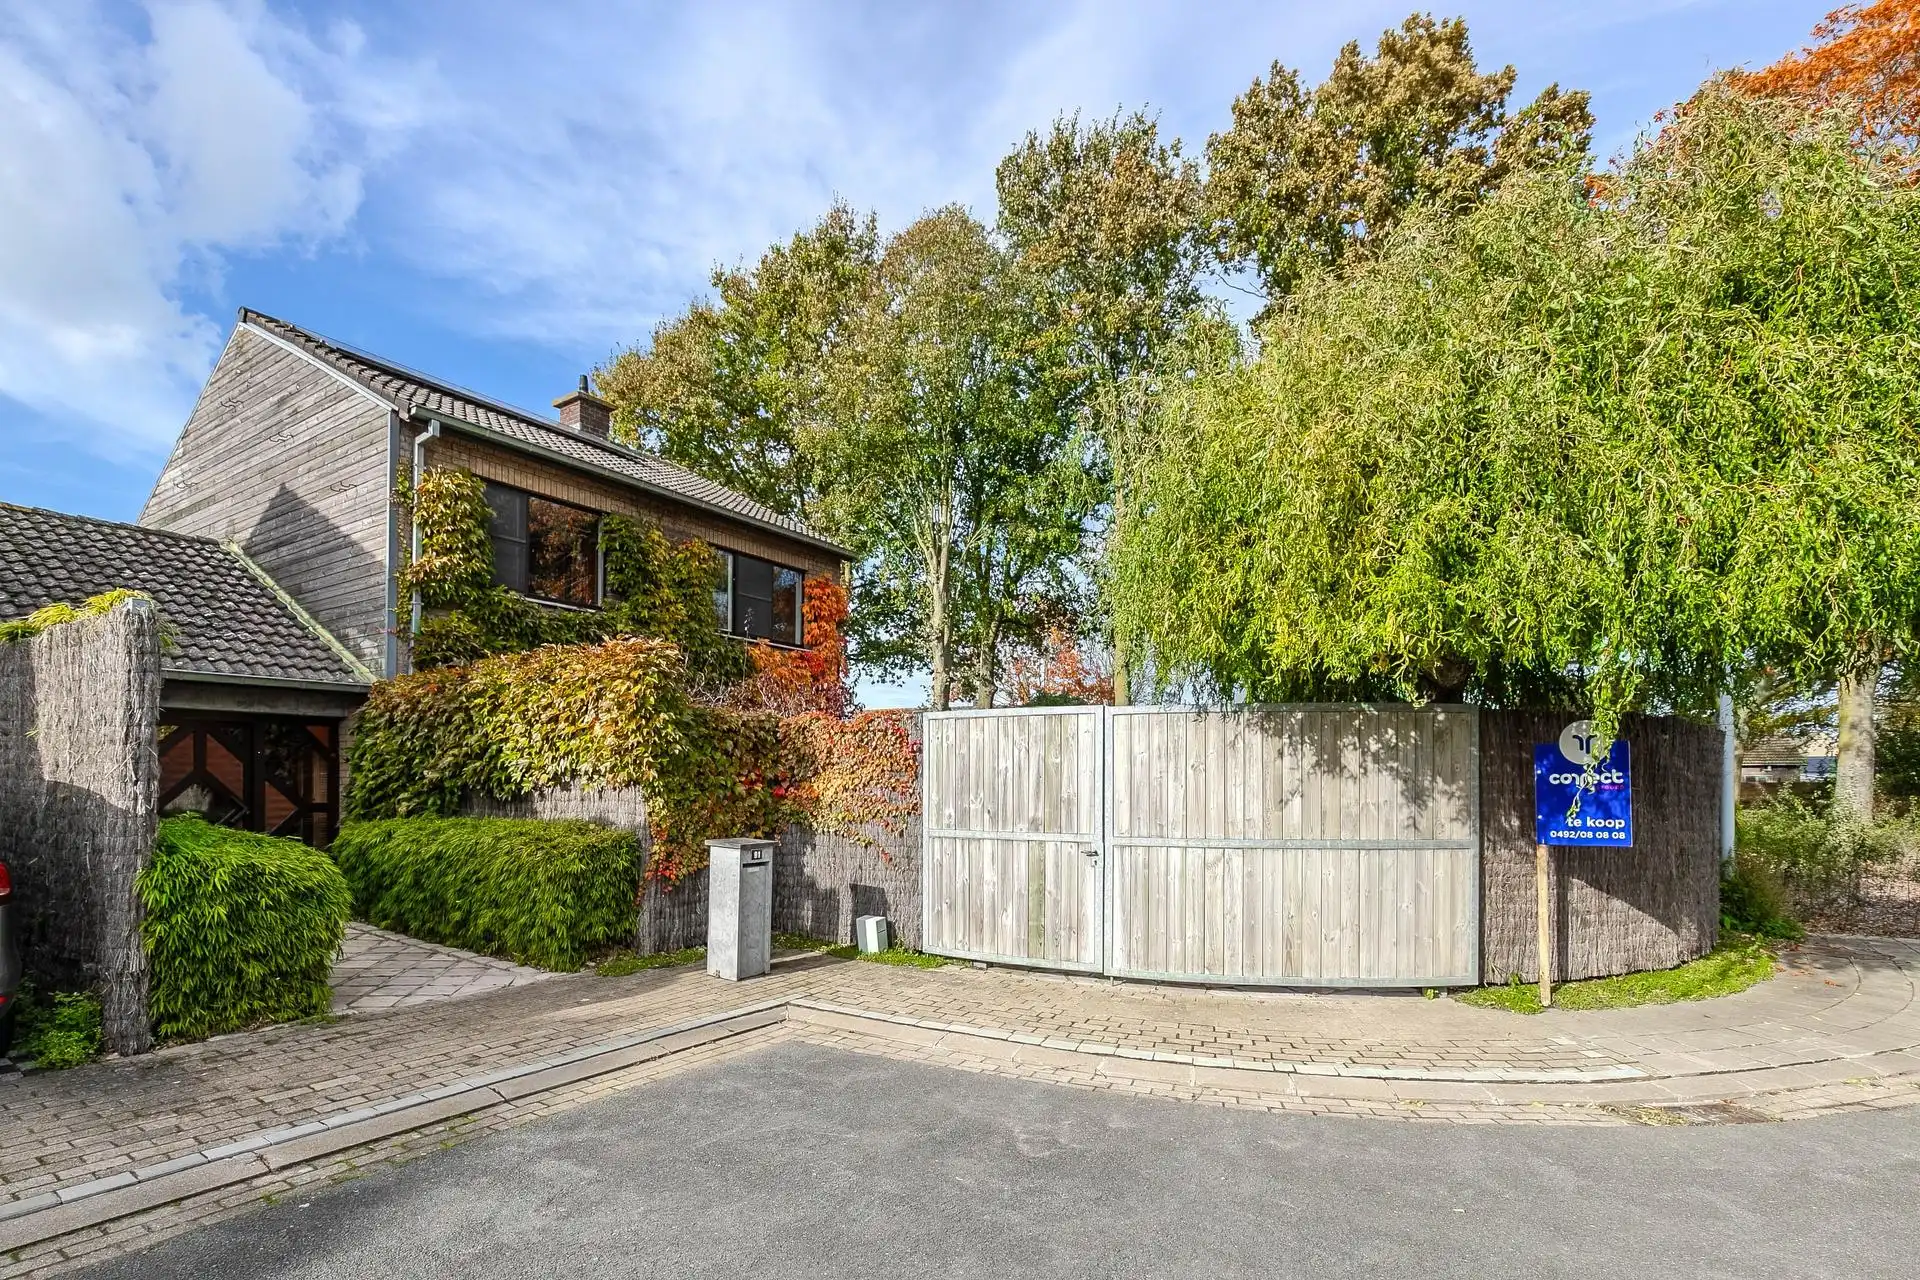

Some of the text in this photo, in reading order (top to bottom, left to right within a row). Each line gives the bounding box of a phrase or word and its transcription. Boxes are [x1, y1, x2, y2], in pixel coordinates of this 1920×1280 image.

[1568, 816, 1625, 829] te koop
[1550, 830, 1593, 839] 0492/08
[1595, 831, 1609, 839] 08
